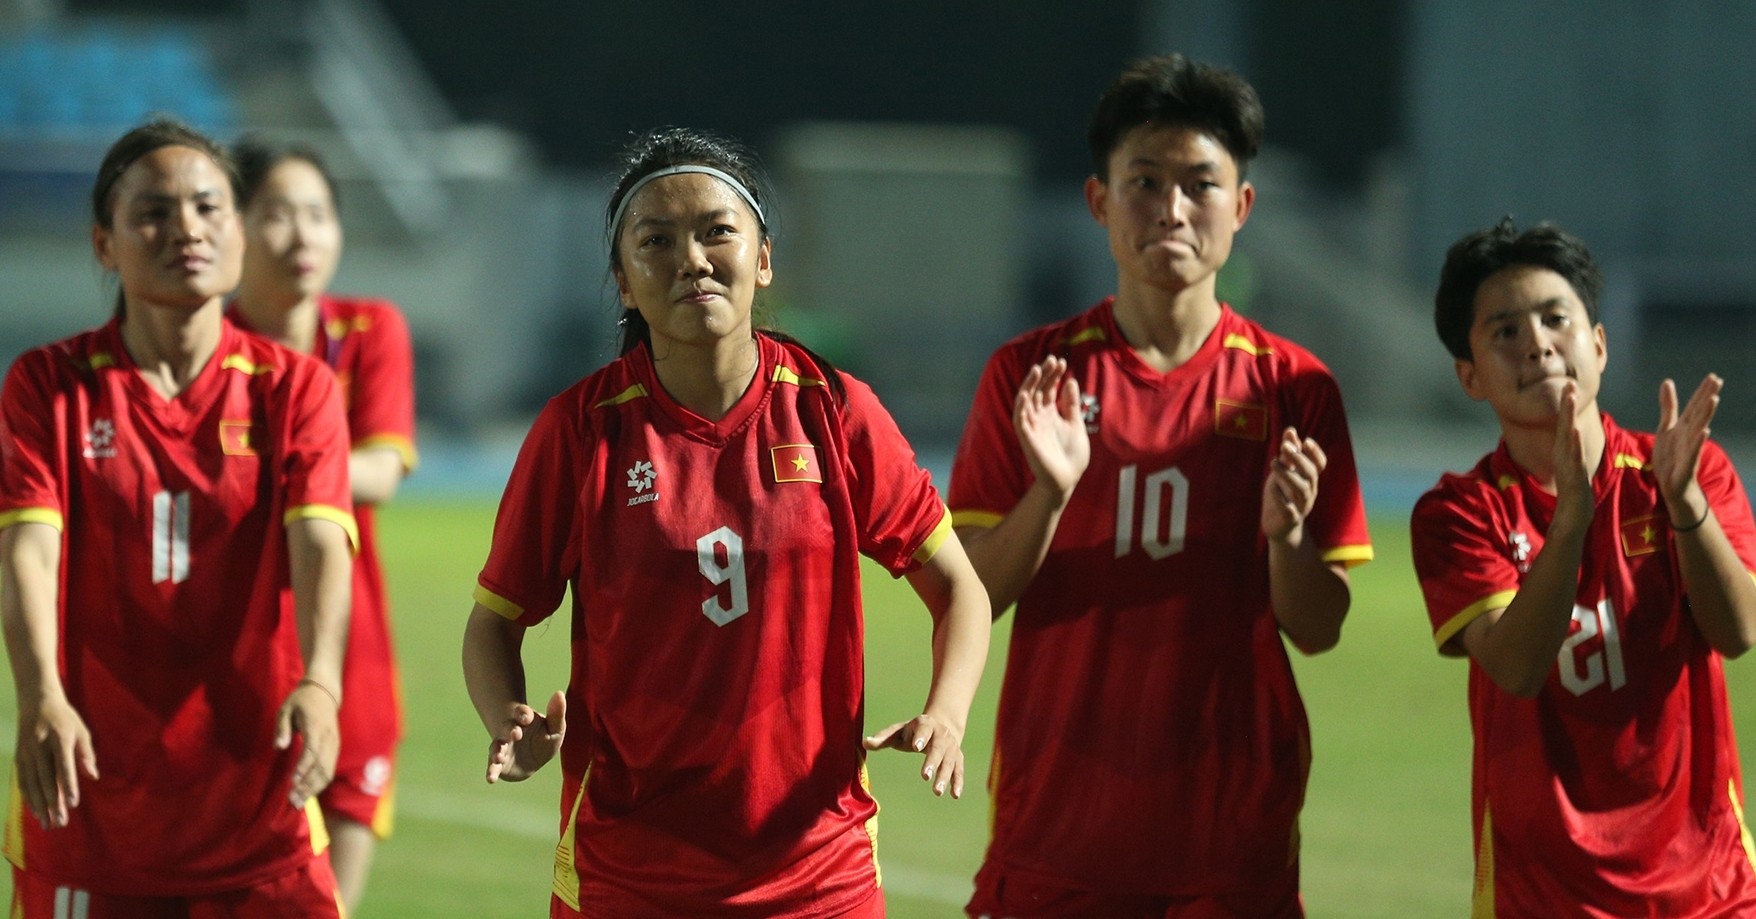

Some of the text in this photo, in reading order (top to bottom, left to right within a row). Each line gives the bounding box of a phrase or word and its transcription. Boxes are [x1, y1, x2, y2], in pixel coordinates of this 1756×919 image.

[152, 489, 190, 585] 11
[1115, 463, 1190, 561] 10
[696, 525, 749, 628] 9
[1557, 597, 1627, 697] 21
